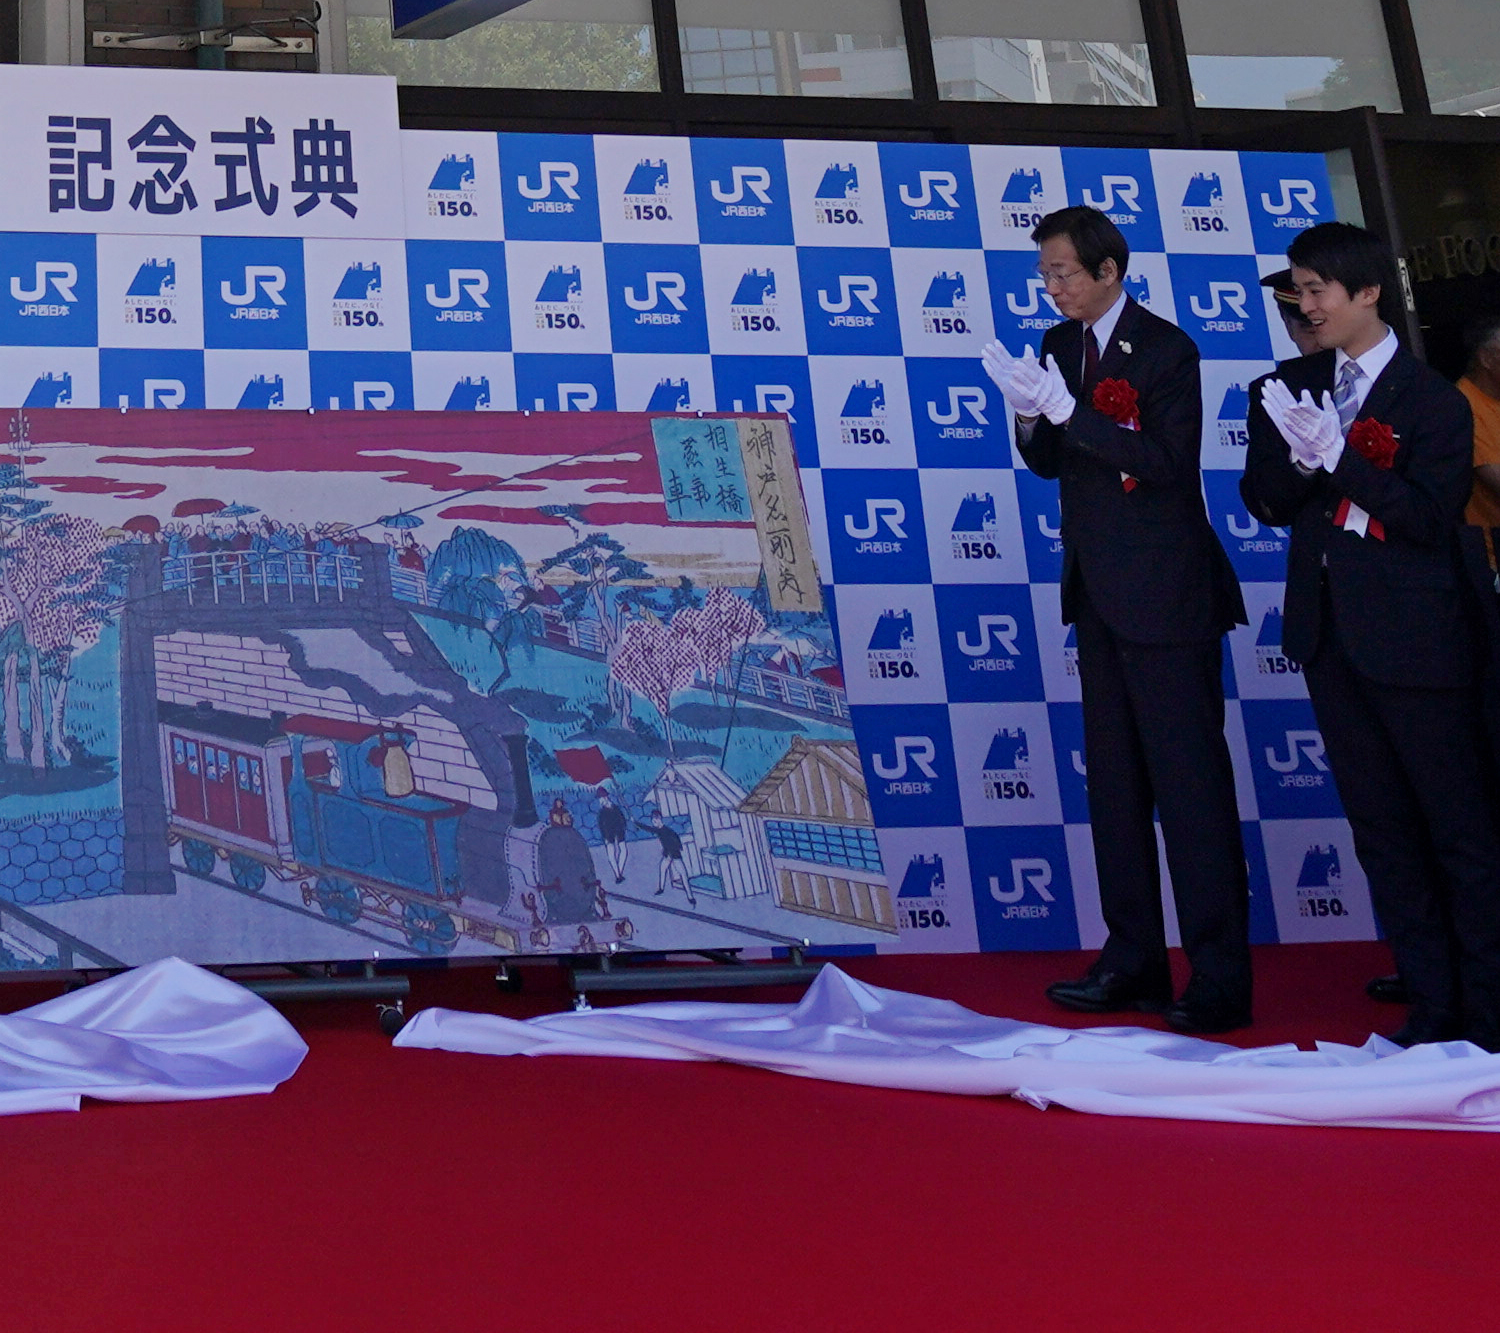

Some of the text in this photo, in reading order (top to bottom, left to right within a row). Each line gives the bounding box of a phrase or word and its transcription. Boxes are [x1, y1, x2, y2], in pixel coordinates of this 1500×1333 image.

[47, 114, 359, 219] 記念式典
[518, 162, 580, 199] JR
[711, 167, 772, 203] JR
[528, 202, 574, 212] JR西日本
[899, 171, 959, 207] JR
[1261, 179, 1320, 215] JR
[722, 206, 766, 216] JR西日本
[11, 262, 77, 302] JR
[221, 266, 286, 305] JR
[426, 269, 490, 307] JR
[625, 273, 687, 310] JR
[818, 276, 880, 313] JR
[1190, 282, 1249, 318] JR
[19, 305, 69, 316] JR西日本
[231, 308, 279, 319] JR西日本
[436, 311, 483, 321] JR西日本
[635, 314, 680, 324] JR西日本
[829, 316, 873, 326] JR西日本
[928, 387, 988, 424] JR
[845, 499, 907, 538] JR
[856, 542, 902, 553] JR西日本
[956, 615, 1020, 655] JR
[873, 736, 938, 779] JR
[1265, 730, 1330, 771] JR
[990, 858, 1055, 903] JR
